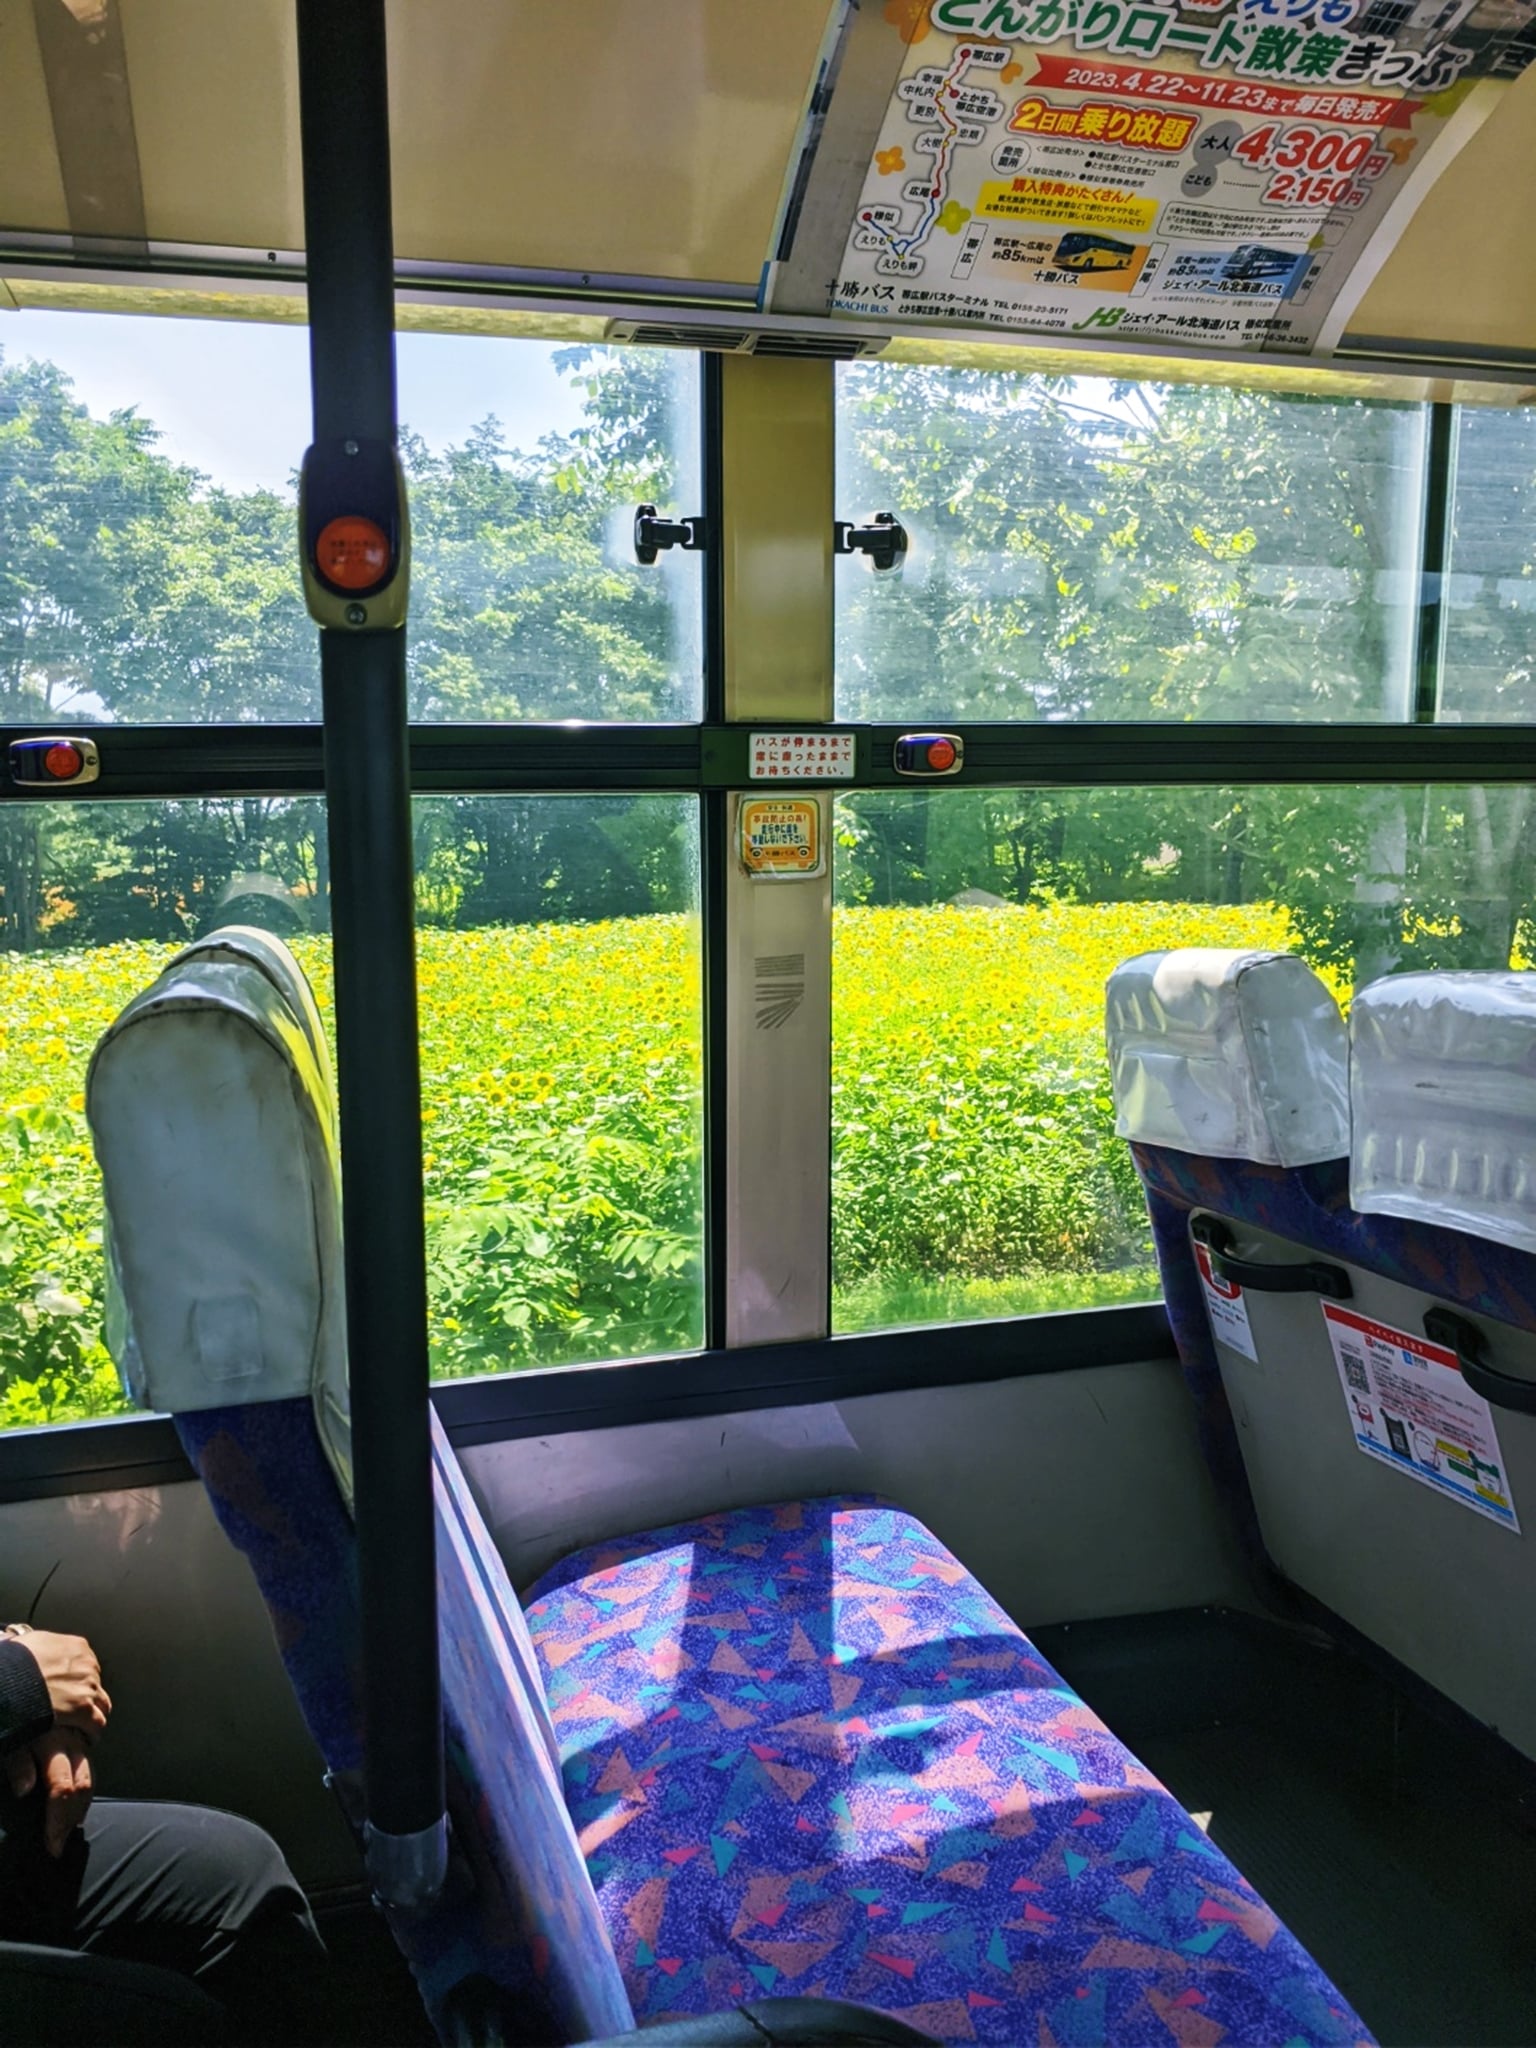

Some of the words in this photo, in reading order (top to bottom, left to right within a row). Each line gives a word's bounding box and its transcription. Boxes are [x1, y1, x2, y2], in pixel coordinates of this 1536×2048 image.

[938, 0, 1466, 86] とんがりロード散策きっぷ
[972, 50, 1005, 63] 帯広駅
[903, 86, 936, 97] 中札内
[960, 91, 990, 104] とかち
[914, 105, 937, 118] 更別
[955, 102, 998, 117] 帯広空港
[1014, 102, 1193, 148] 2日間乗り放題
[921, 136, 942, 148] 大樹
[1200, 134, 1230, 150] 大人
[1236, 126, 1388, 177] 4,300円
[909, 186, 931, 198] 広尾
[1185, 174, 1212, 187] こども
[1266, 173, 1365, 206] 2,150円
[874, 211, 895, 222] 様似
[860, 235, 887, 246] えりも
[961, 238, 980, 264] 帯広
[992, 250, 1045, 264] 約85kmは
[1139, 258, 1159, 282] 広尾
[1033, 270, 1079, 285] 十勝バス
[825, 279, 895, 300] 十勝バス
[826, 299, 868, 313] TOKACHI
[870, 303, 889, 314] BUS
[994, 300, 1009, 310] TEL
[989, 312, 1004, 323] TEL
[755, 737, 850, 748] バスが停まるまで
[755, 752, 850, 762] 席に座ったままで
